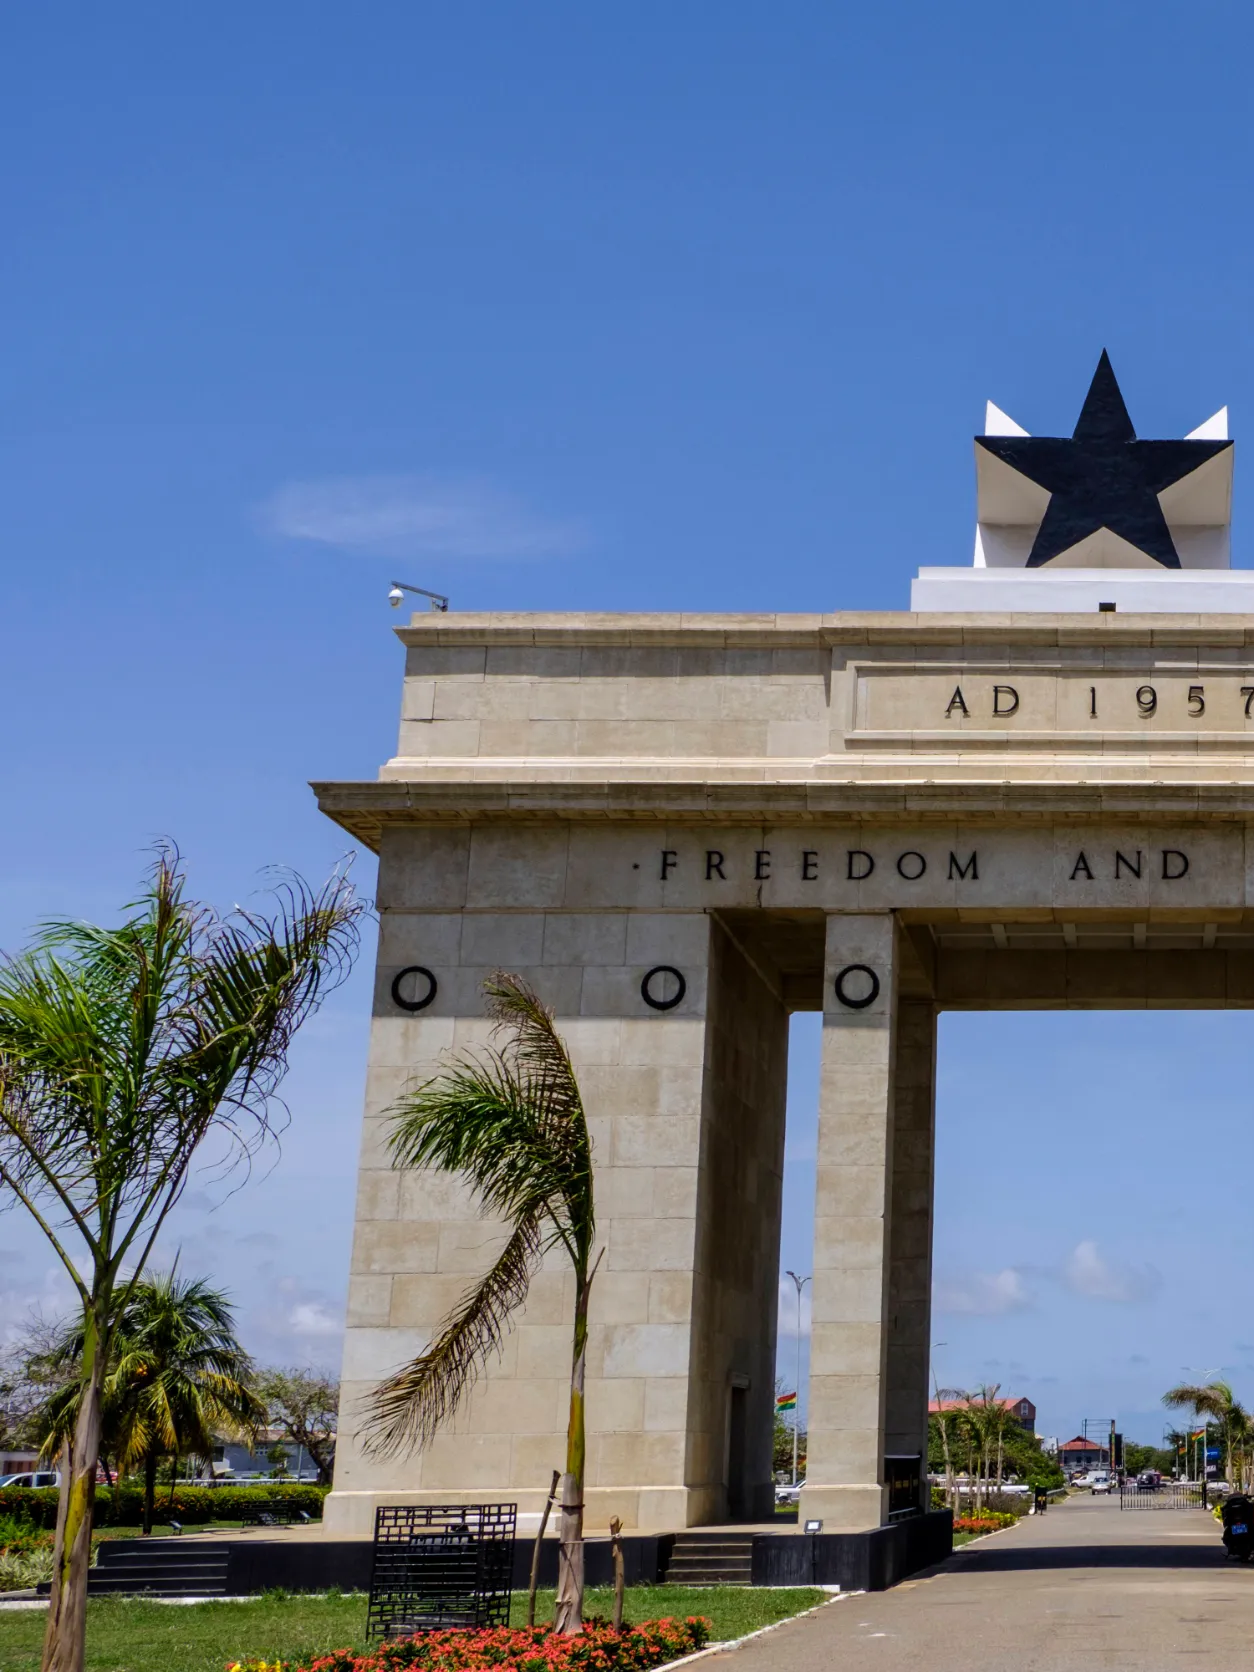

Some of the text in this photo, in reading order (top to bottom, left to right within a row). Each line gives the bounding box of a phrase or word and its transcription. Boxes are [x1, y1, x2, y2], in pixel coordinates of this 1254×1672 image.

[945, 685, 1021, 716] AD
[659, 850, 980, 881] FREEDOM
[1068, 850, 1191, 881] AND
